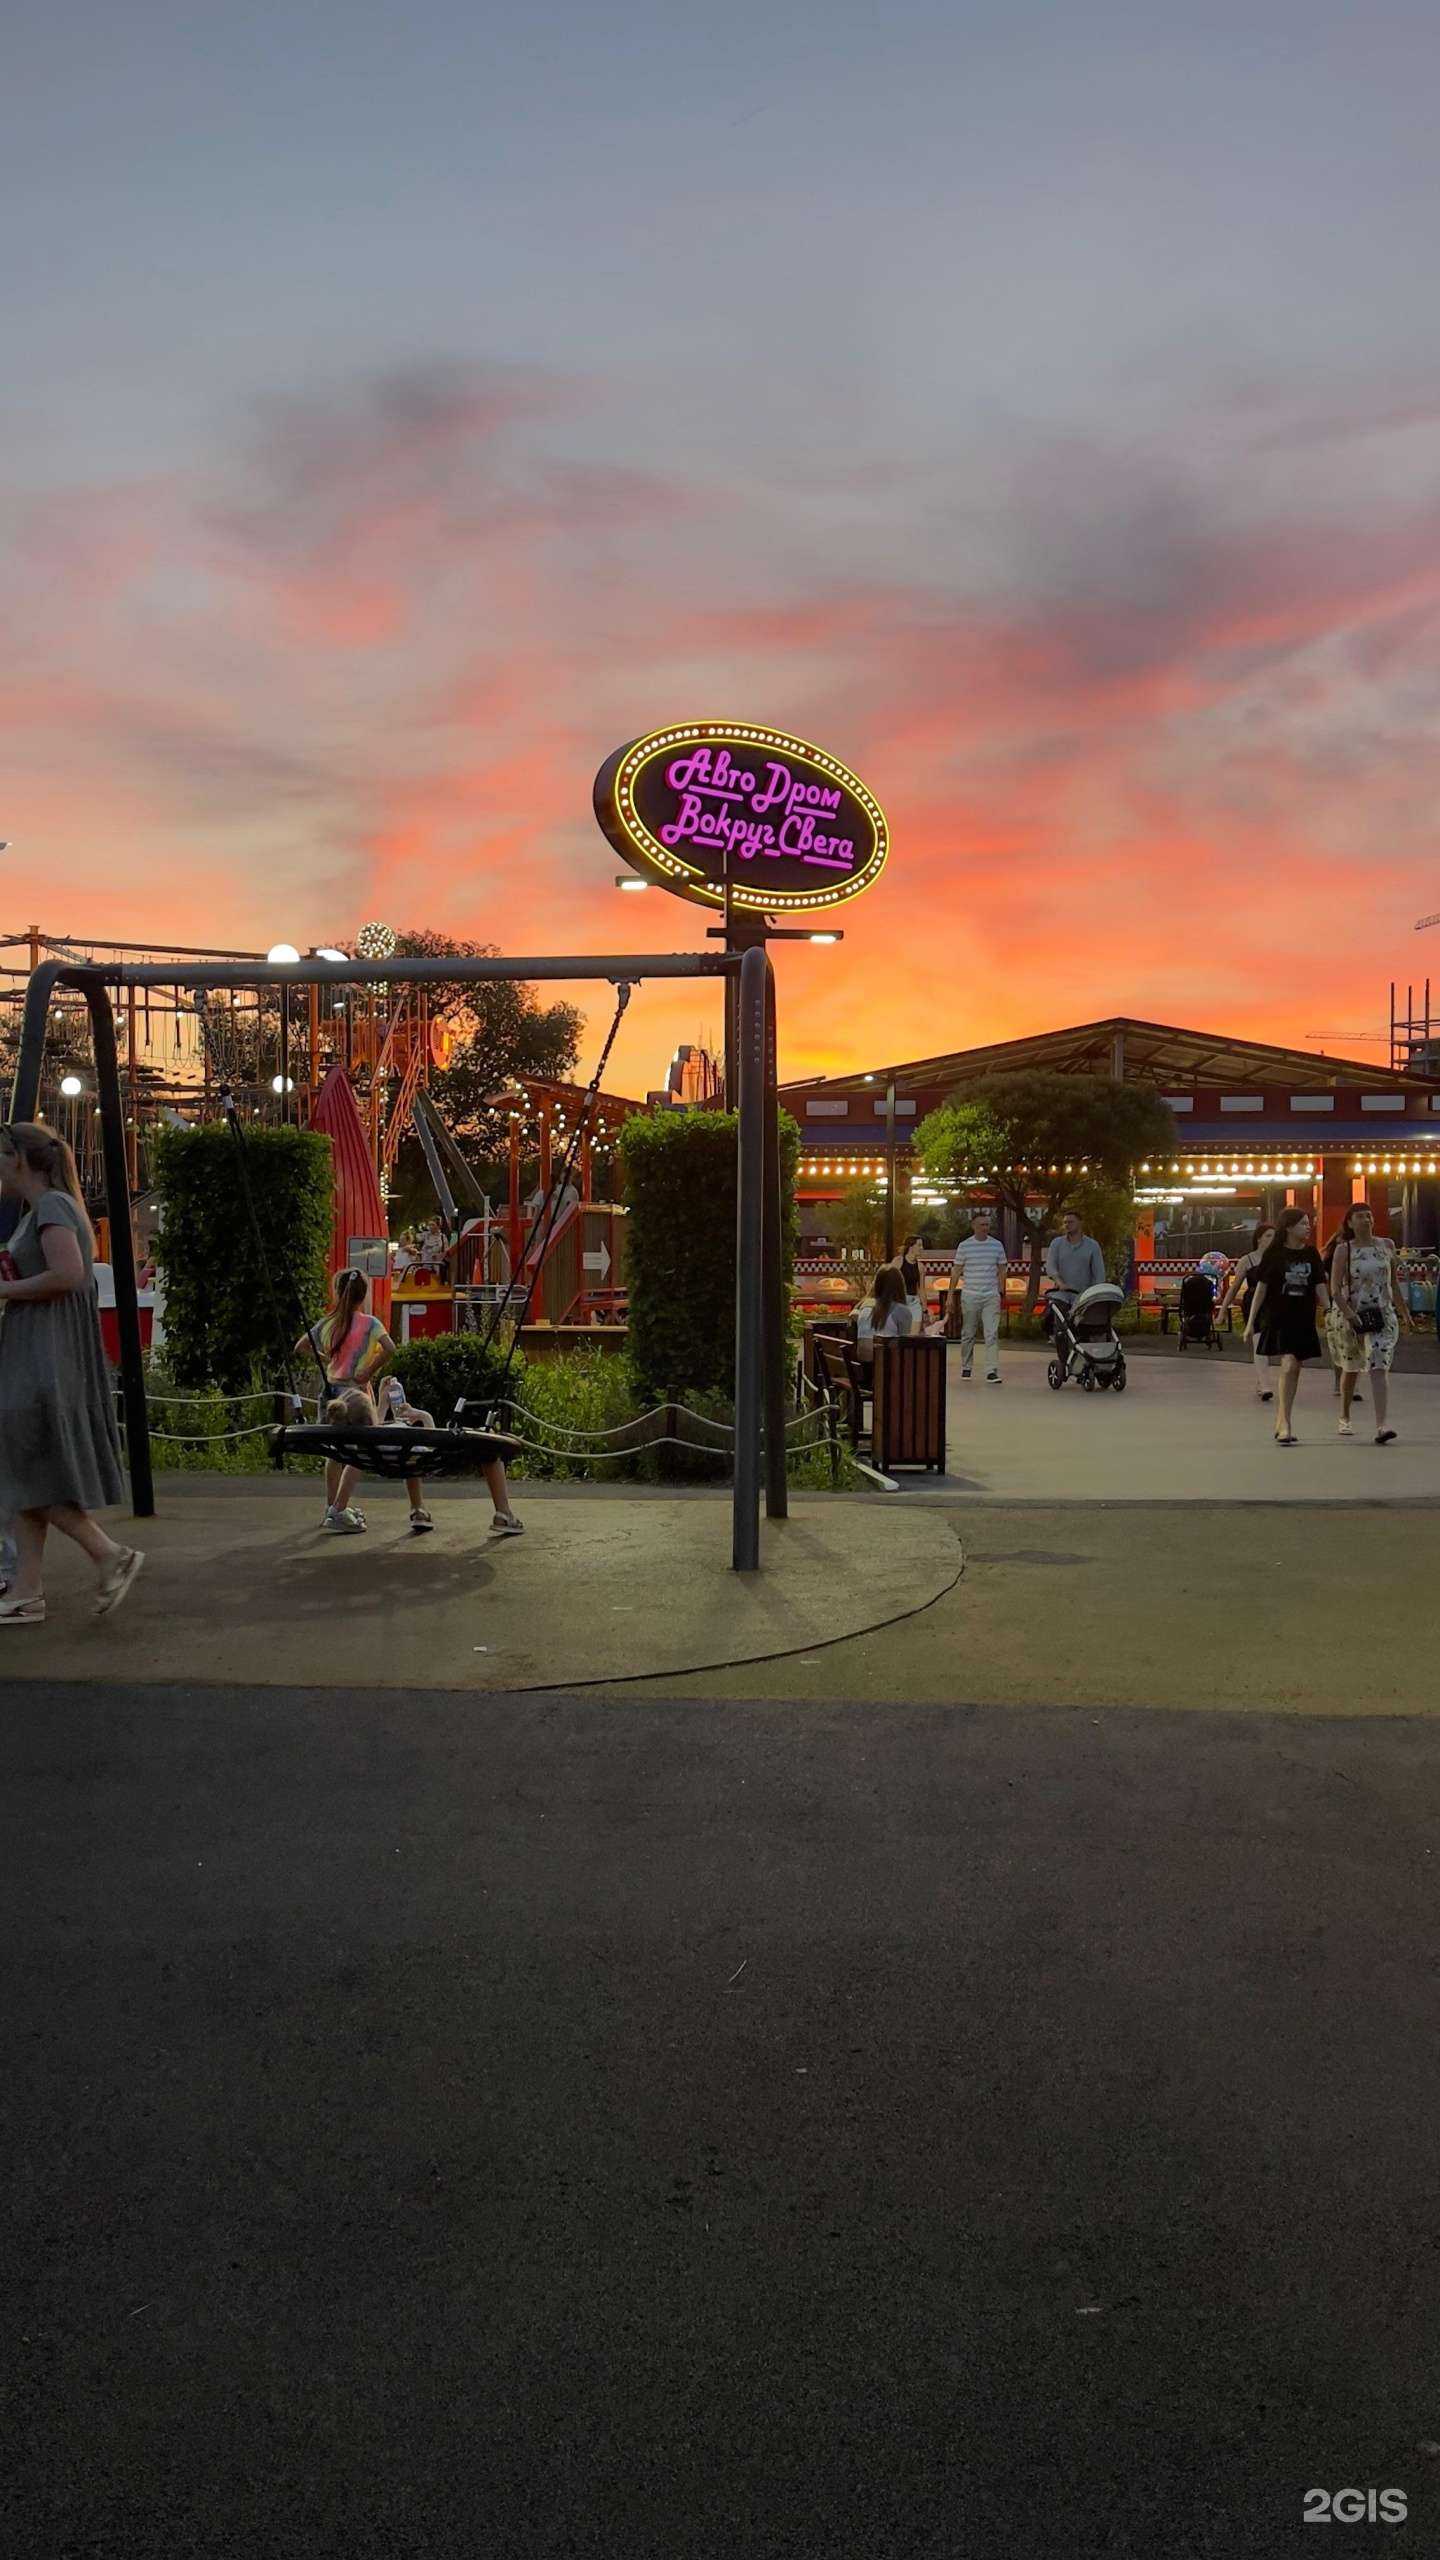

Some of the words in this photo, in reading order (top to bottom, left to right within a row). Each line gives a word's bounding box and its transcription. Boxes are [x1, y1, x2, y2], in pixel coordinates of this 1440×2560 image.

[665, 748, 756, 792] Авто
[751, 761, 842, 816] Дром
[660, 793, 776, 859] Вокруг
[778, 815, 855, 860] Света
